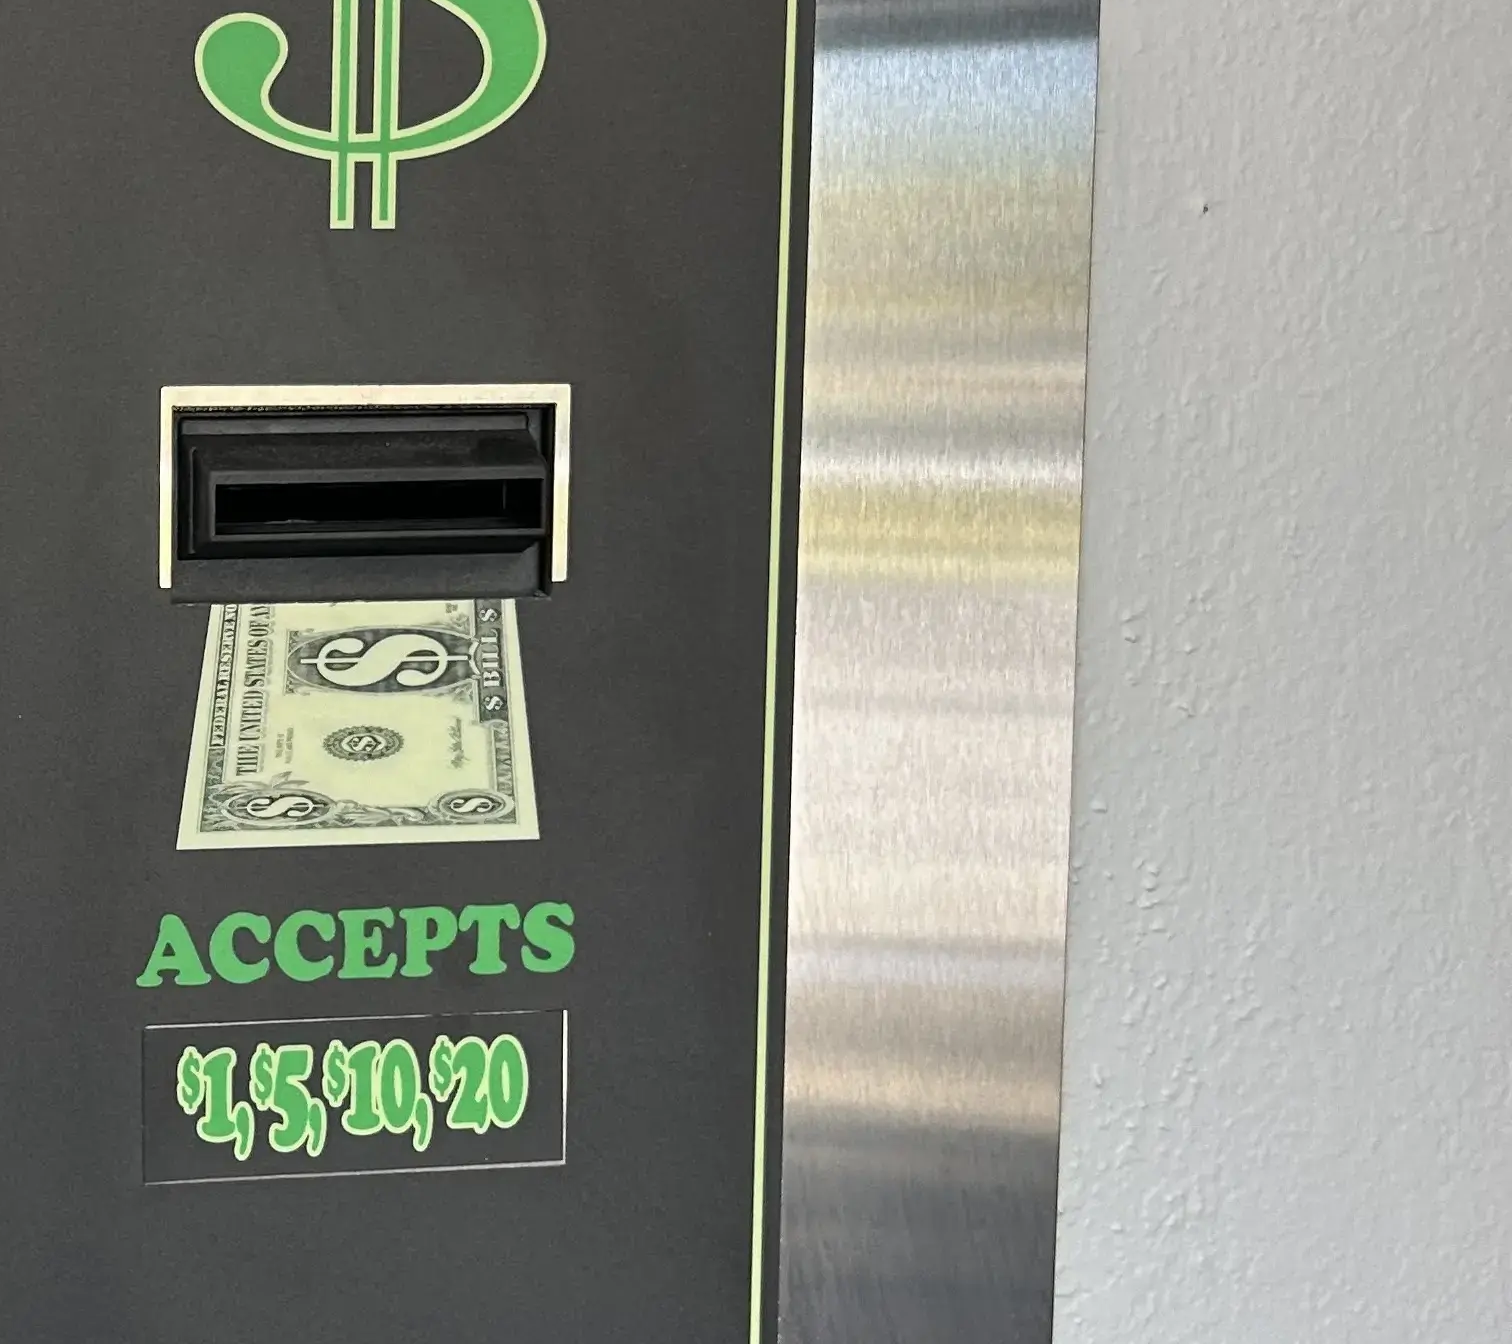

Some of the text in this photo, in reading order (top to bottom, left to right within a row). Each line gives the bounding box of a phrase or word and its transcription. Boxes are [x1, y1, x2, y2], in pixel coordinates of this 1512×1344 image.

[216, 621, 235, 681] RESERVE
[247, 621, 270, 638] OF
[243, 639, 268, 688] STATES
[479, 628, 501, 688] BILL
[210, 681, 229, 746] FEDERAL
[237, 691, 264, 742] UNITED
[236, 745, 259, 776] THE
[135, 901, 575, 987] ACCEPTS
